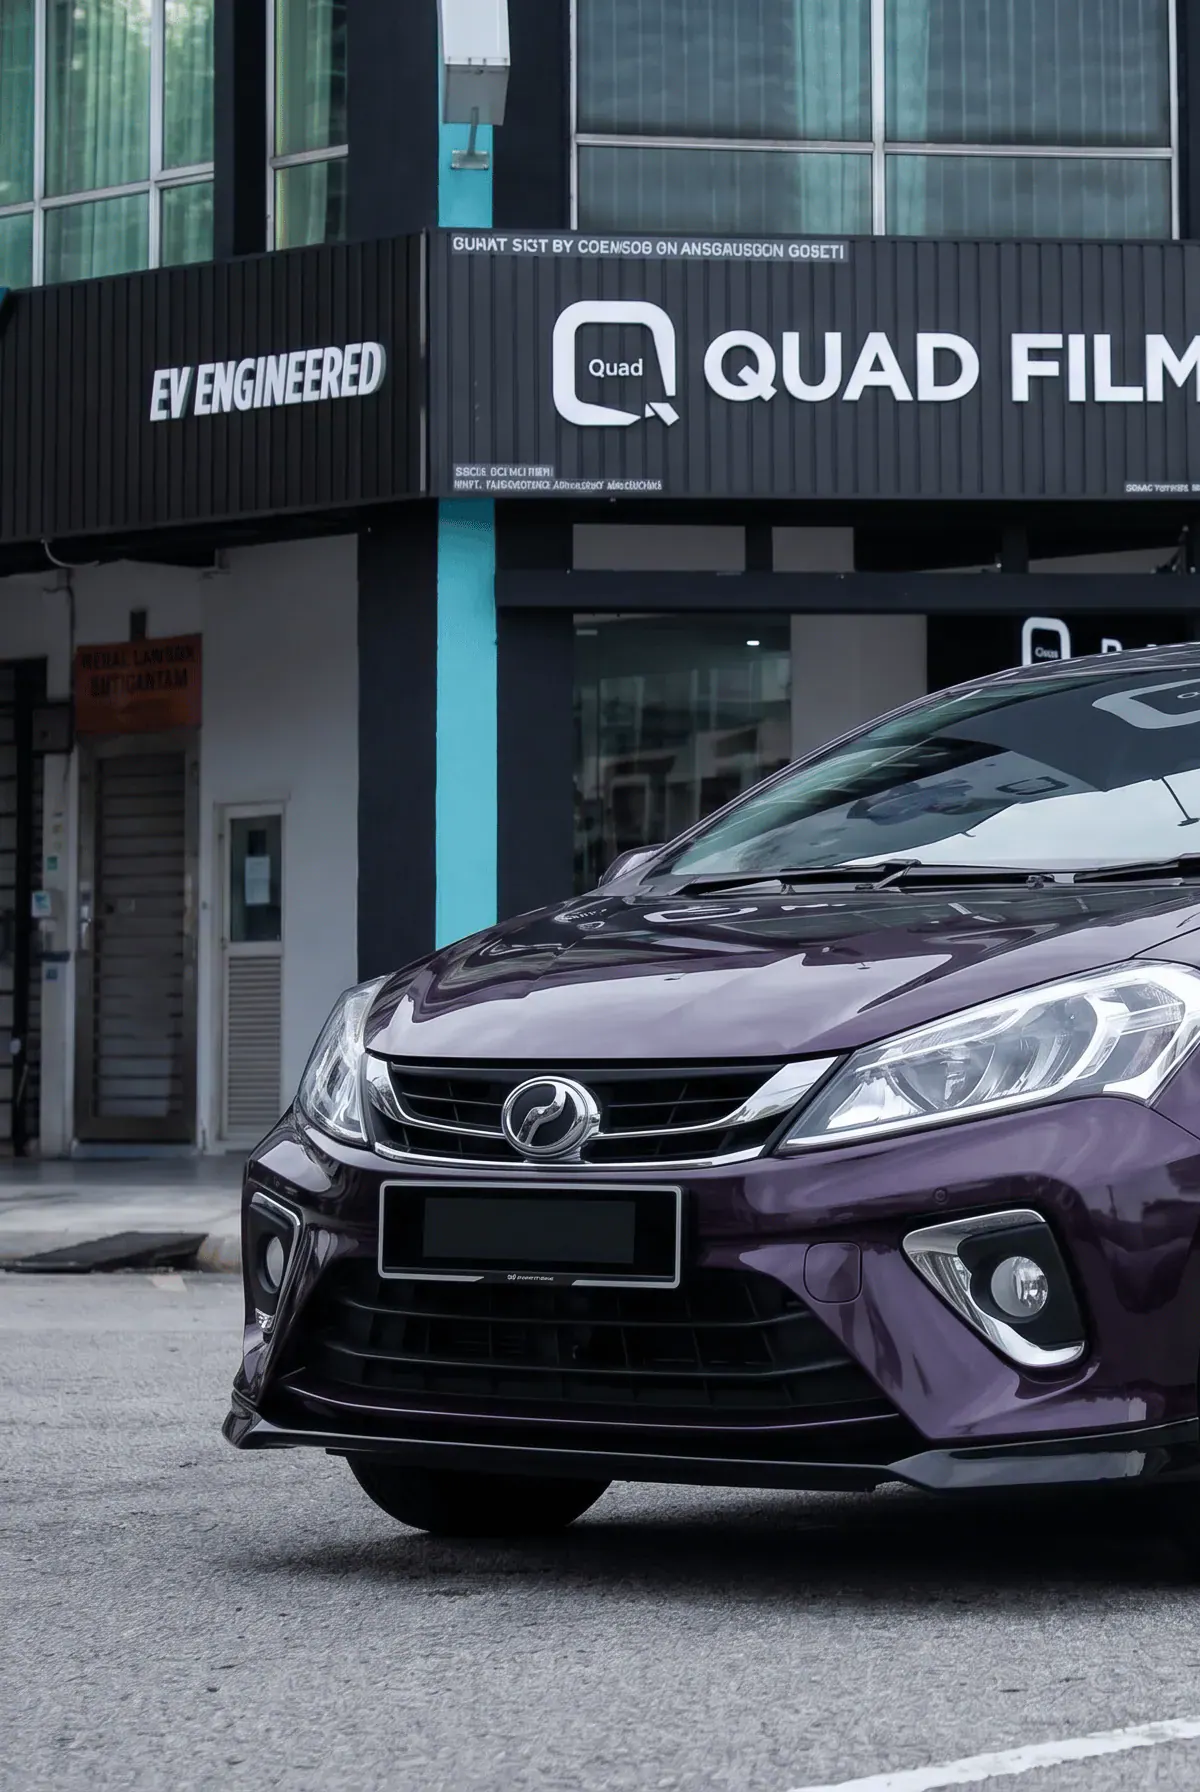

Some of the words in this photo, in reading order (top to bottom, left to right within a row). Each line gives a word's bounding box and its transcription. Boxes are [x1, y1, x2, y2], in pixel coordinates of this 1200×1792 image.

[552, 239, 574, 253] BY
[150, 366, 194, 421] EV
[193, 341, 386, 416] ENGINEERED
[588, 358, 644, 378] Quad
[703, 329, 980, 402] QUAD
